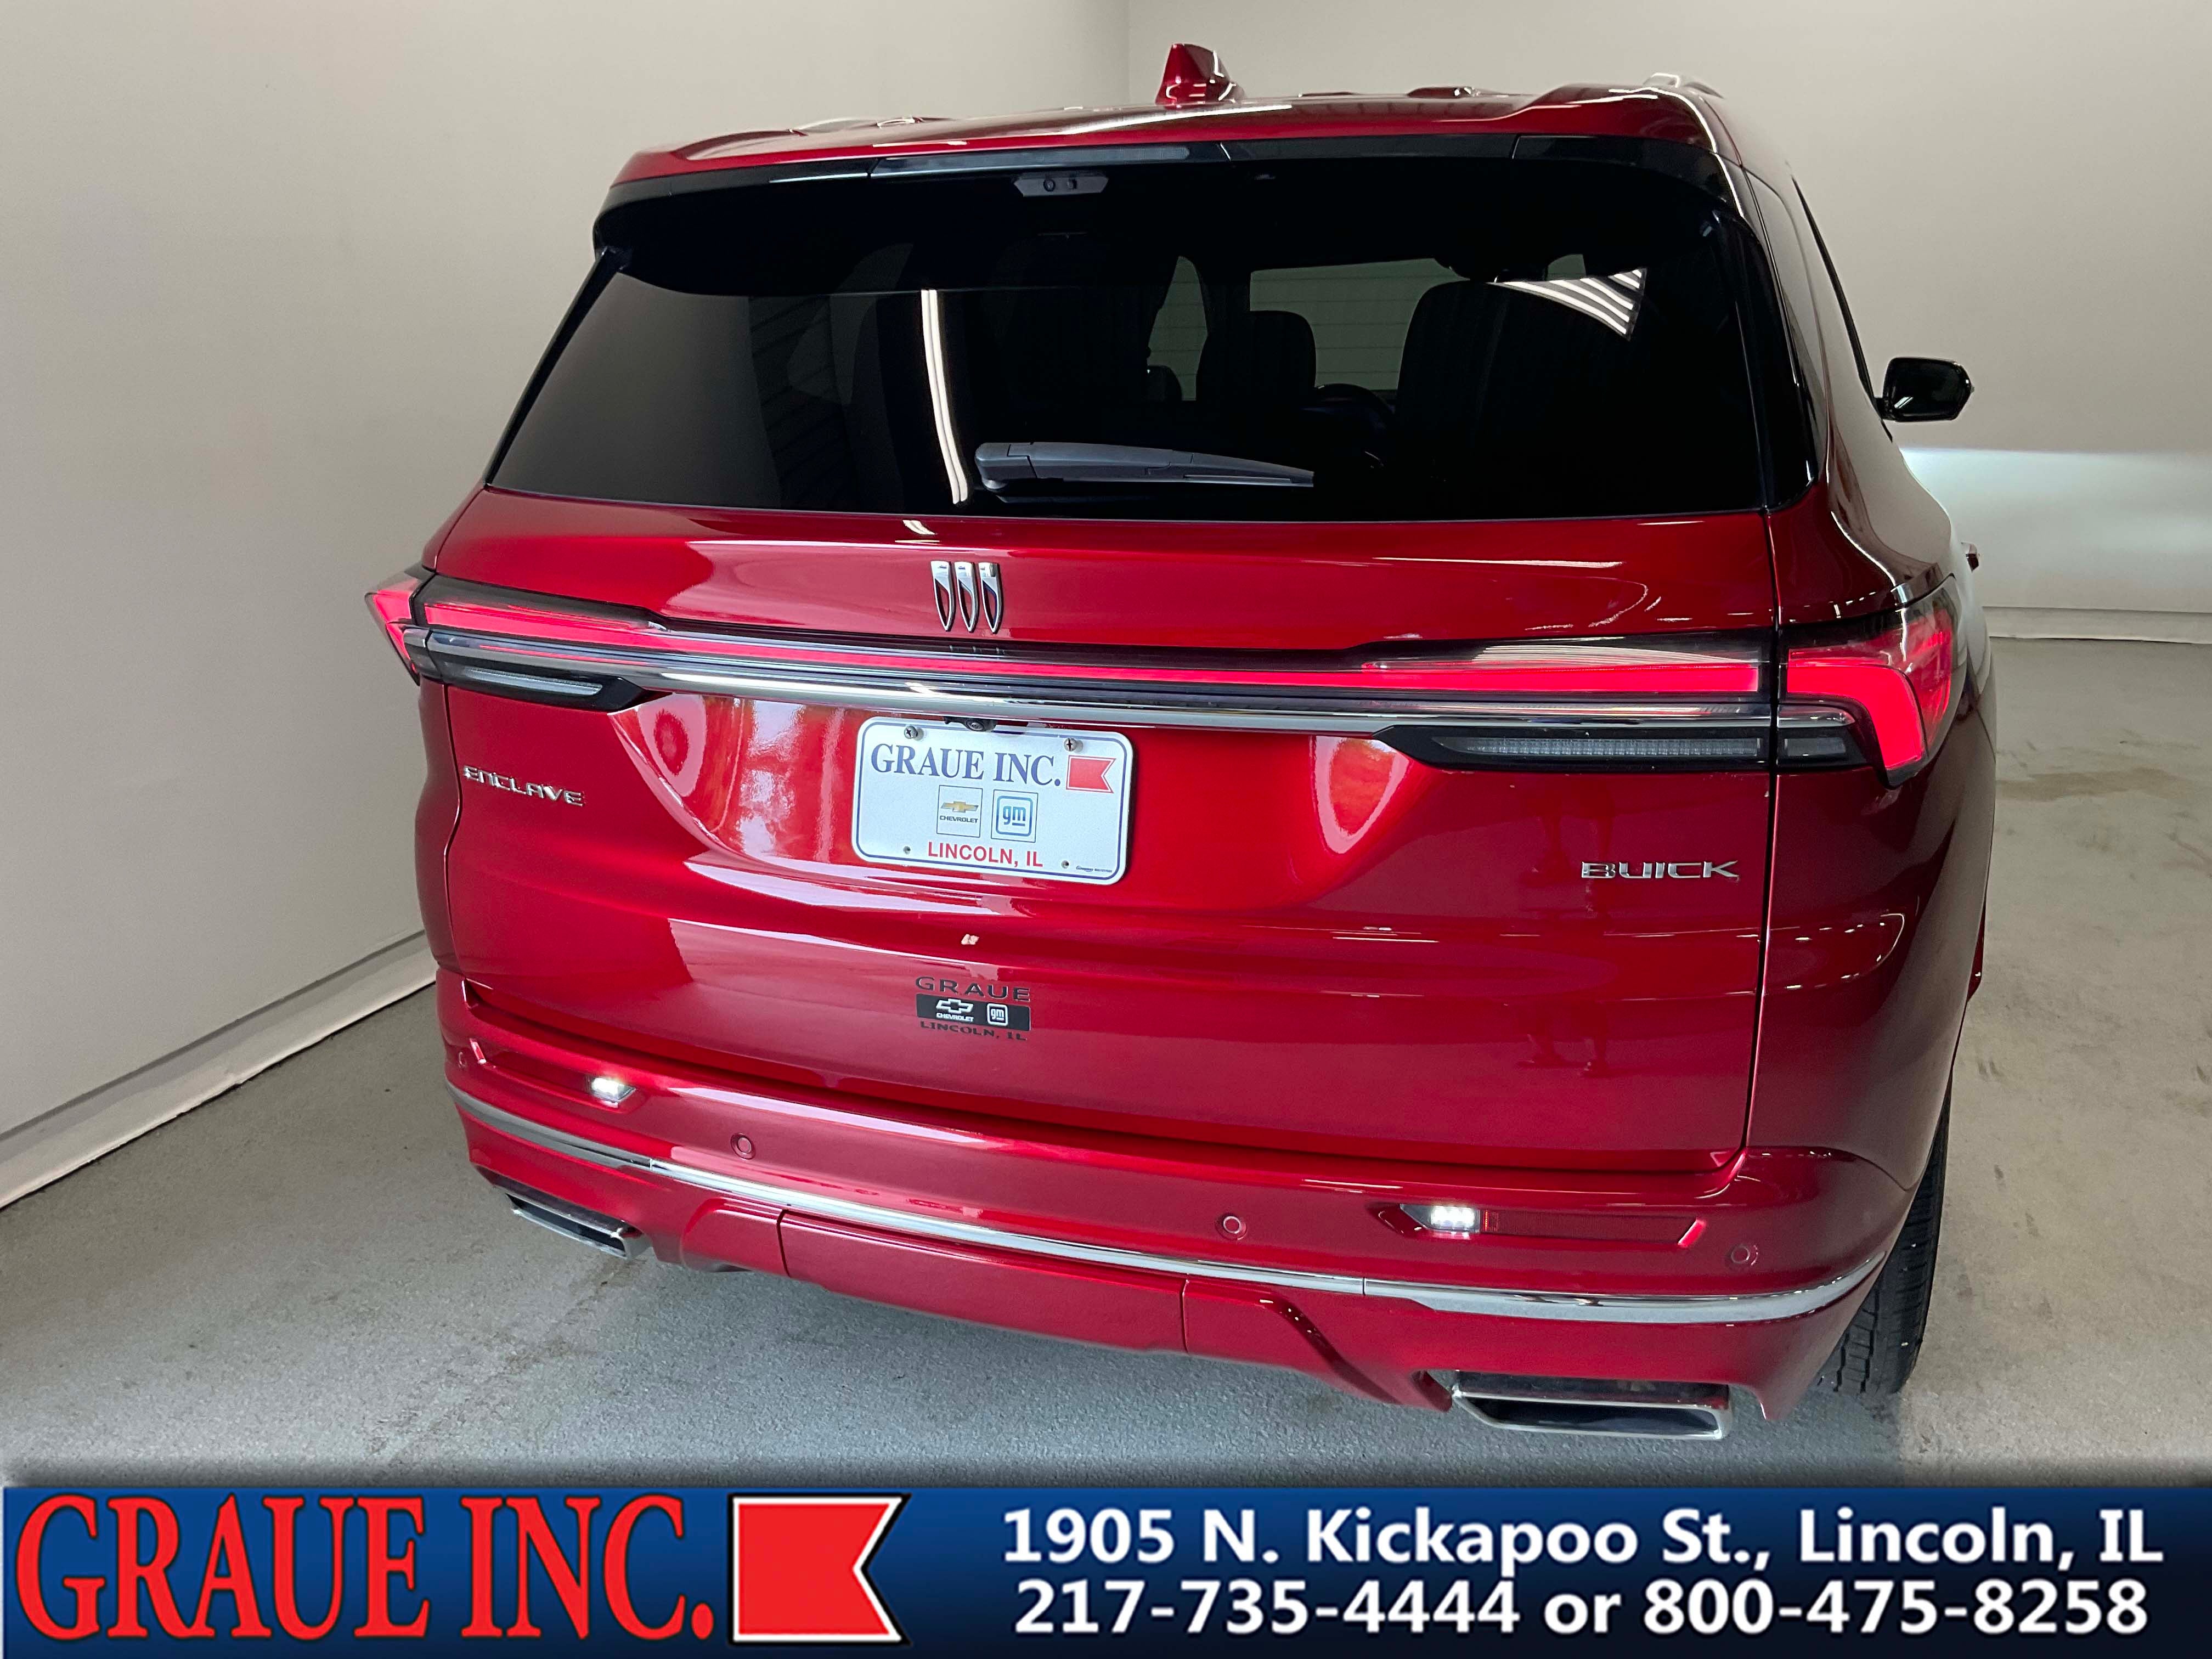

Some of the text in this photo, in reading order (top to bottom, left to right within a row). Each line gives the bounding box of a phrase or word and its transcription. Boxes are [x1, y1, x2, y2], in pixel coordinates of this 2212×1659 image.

[871, 743, 1060, 786] GRAUE INC.
[464, 765, 584, 806] ENCLAVE
[939, 815, 978, 823] CHEVROLET
[1003, 805, 1026, 826] gm
[928, 842, 1043, 867] LINCOLN, IL
[1581, 860, 1739, 878] BUICK
[916, 977, 1030, 1001] GRAUE
[936, 1012, 974, 1022] CHEVROLET
[991, 1008, 1005, 1020] gm
[920, 1021, 1027, 1041] LINCOLN, IL
